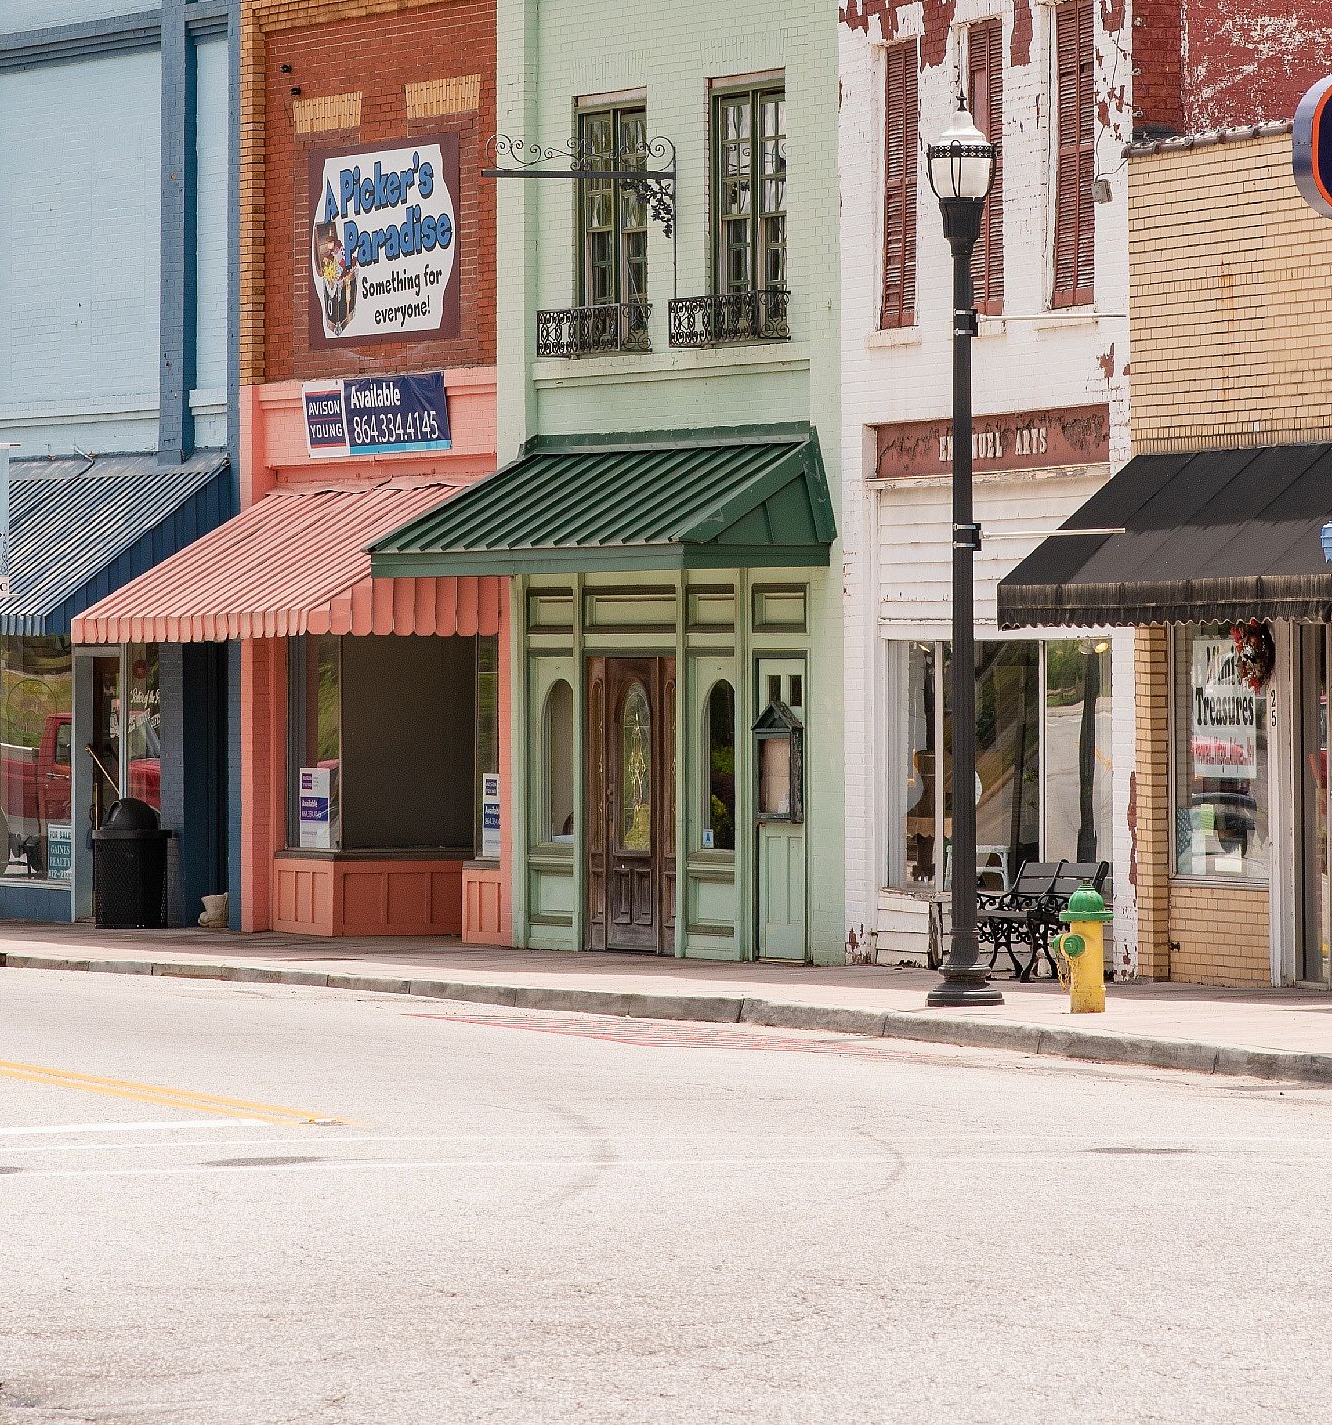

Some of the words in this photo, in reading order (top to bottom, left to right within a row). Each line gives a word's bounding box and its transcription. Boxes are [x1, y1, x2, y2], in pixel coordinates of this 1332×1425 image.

[324, 176, 339, 223] A
[339, 151, 434, 218] Picker's
[343, 204, 453, 271] Paradise
[361, 268, 421, 300] Something
[424, 264, 443, 289] for
[374, 295, 431, 327] everyone!
[308, 399, 341, 416] AVISON
[350, 381, 401, 409] Available
[310, 423, 343, 438] YOUNG
[353, 410, 439, 444] 864.334.4145
[1015, 427, 1047, 455] ARTS
[1195, 687, 1254, 726] Treasures
[50, 845, 71, 855] GAINES
[59, 831, 72, 840] SALE
